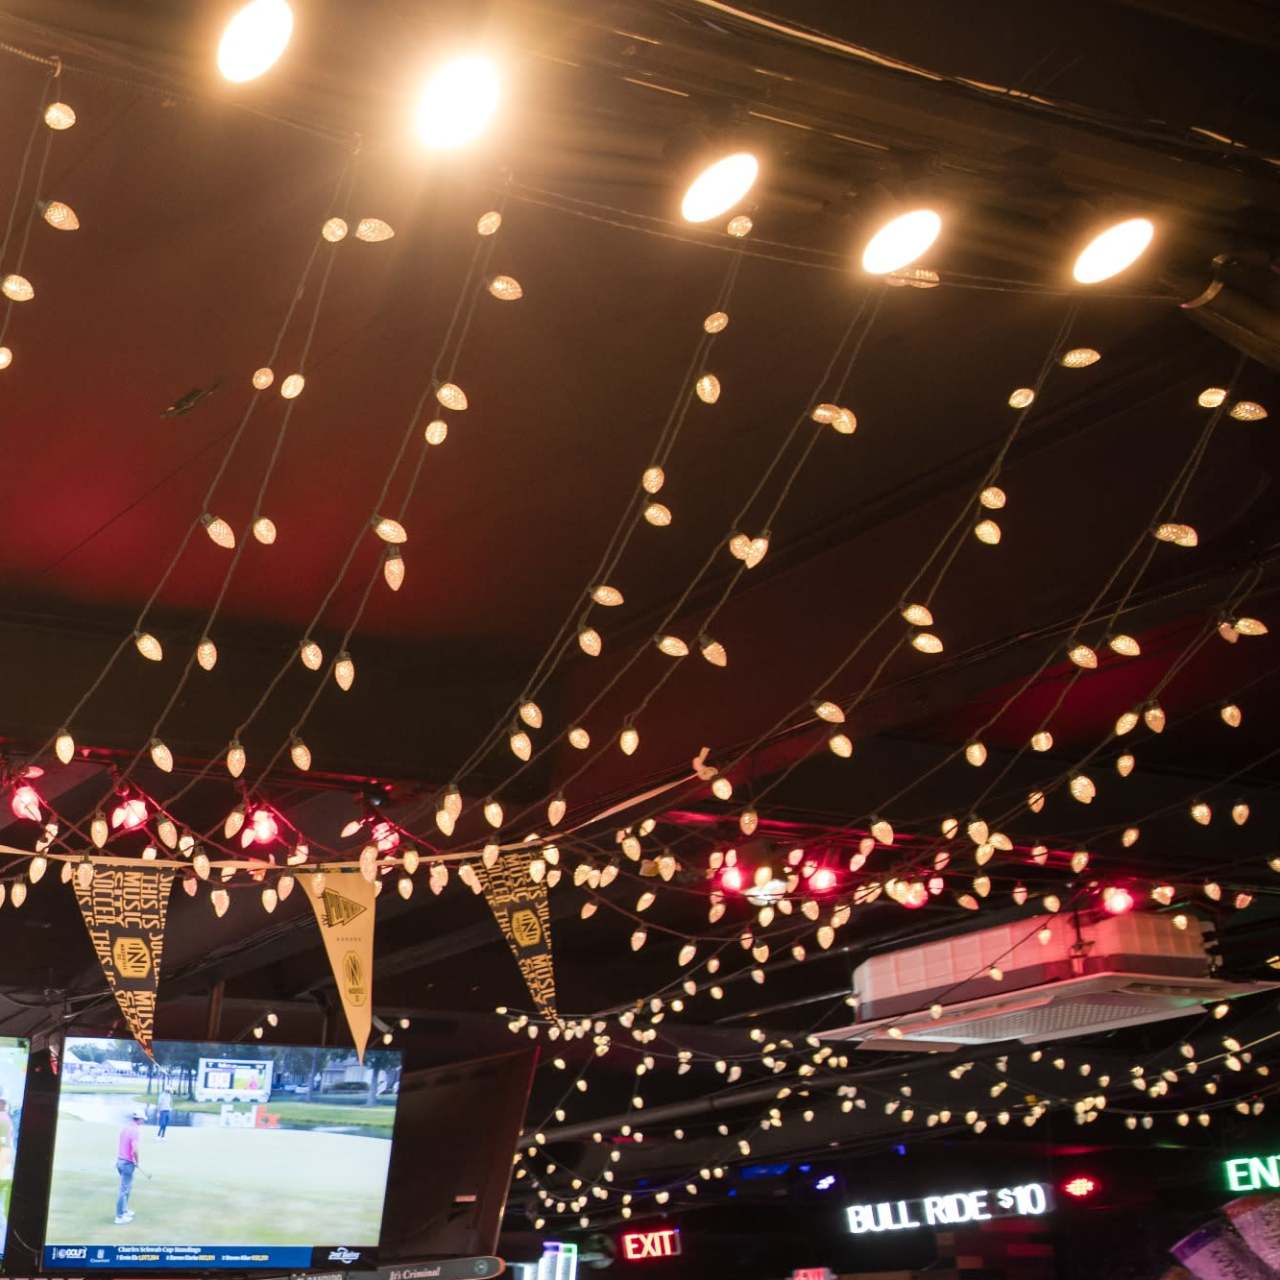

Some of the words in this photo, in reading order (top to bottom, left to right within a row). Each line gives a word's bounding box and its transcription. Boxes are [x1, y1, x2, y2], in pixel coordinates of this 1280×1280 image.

[93, 869, 114, 928] SOCCER
[113, 870, 126, 928] CITY
[122, 871, 144, 928] MUSIC
[140, 872, 159, 910] THIS
[141, 913, 160, 929] IS
[844, 1198, 920, 1234] BULL
[924, 1190, 992, 1225] RIDE
[997, 1183, 1048, 1216] $10
[624, 1229, 674, 1261] EXIT
[389, 1269, 402, 1280] It's
[403, 1265, 442, 1280] Criminal
